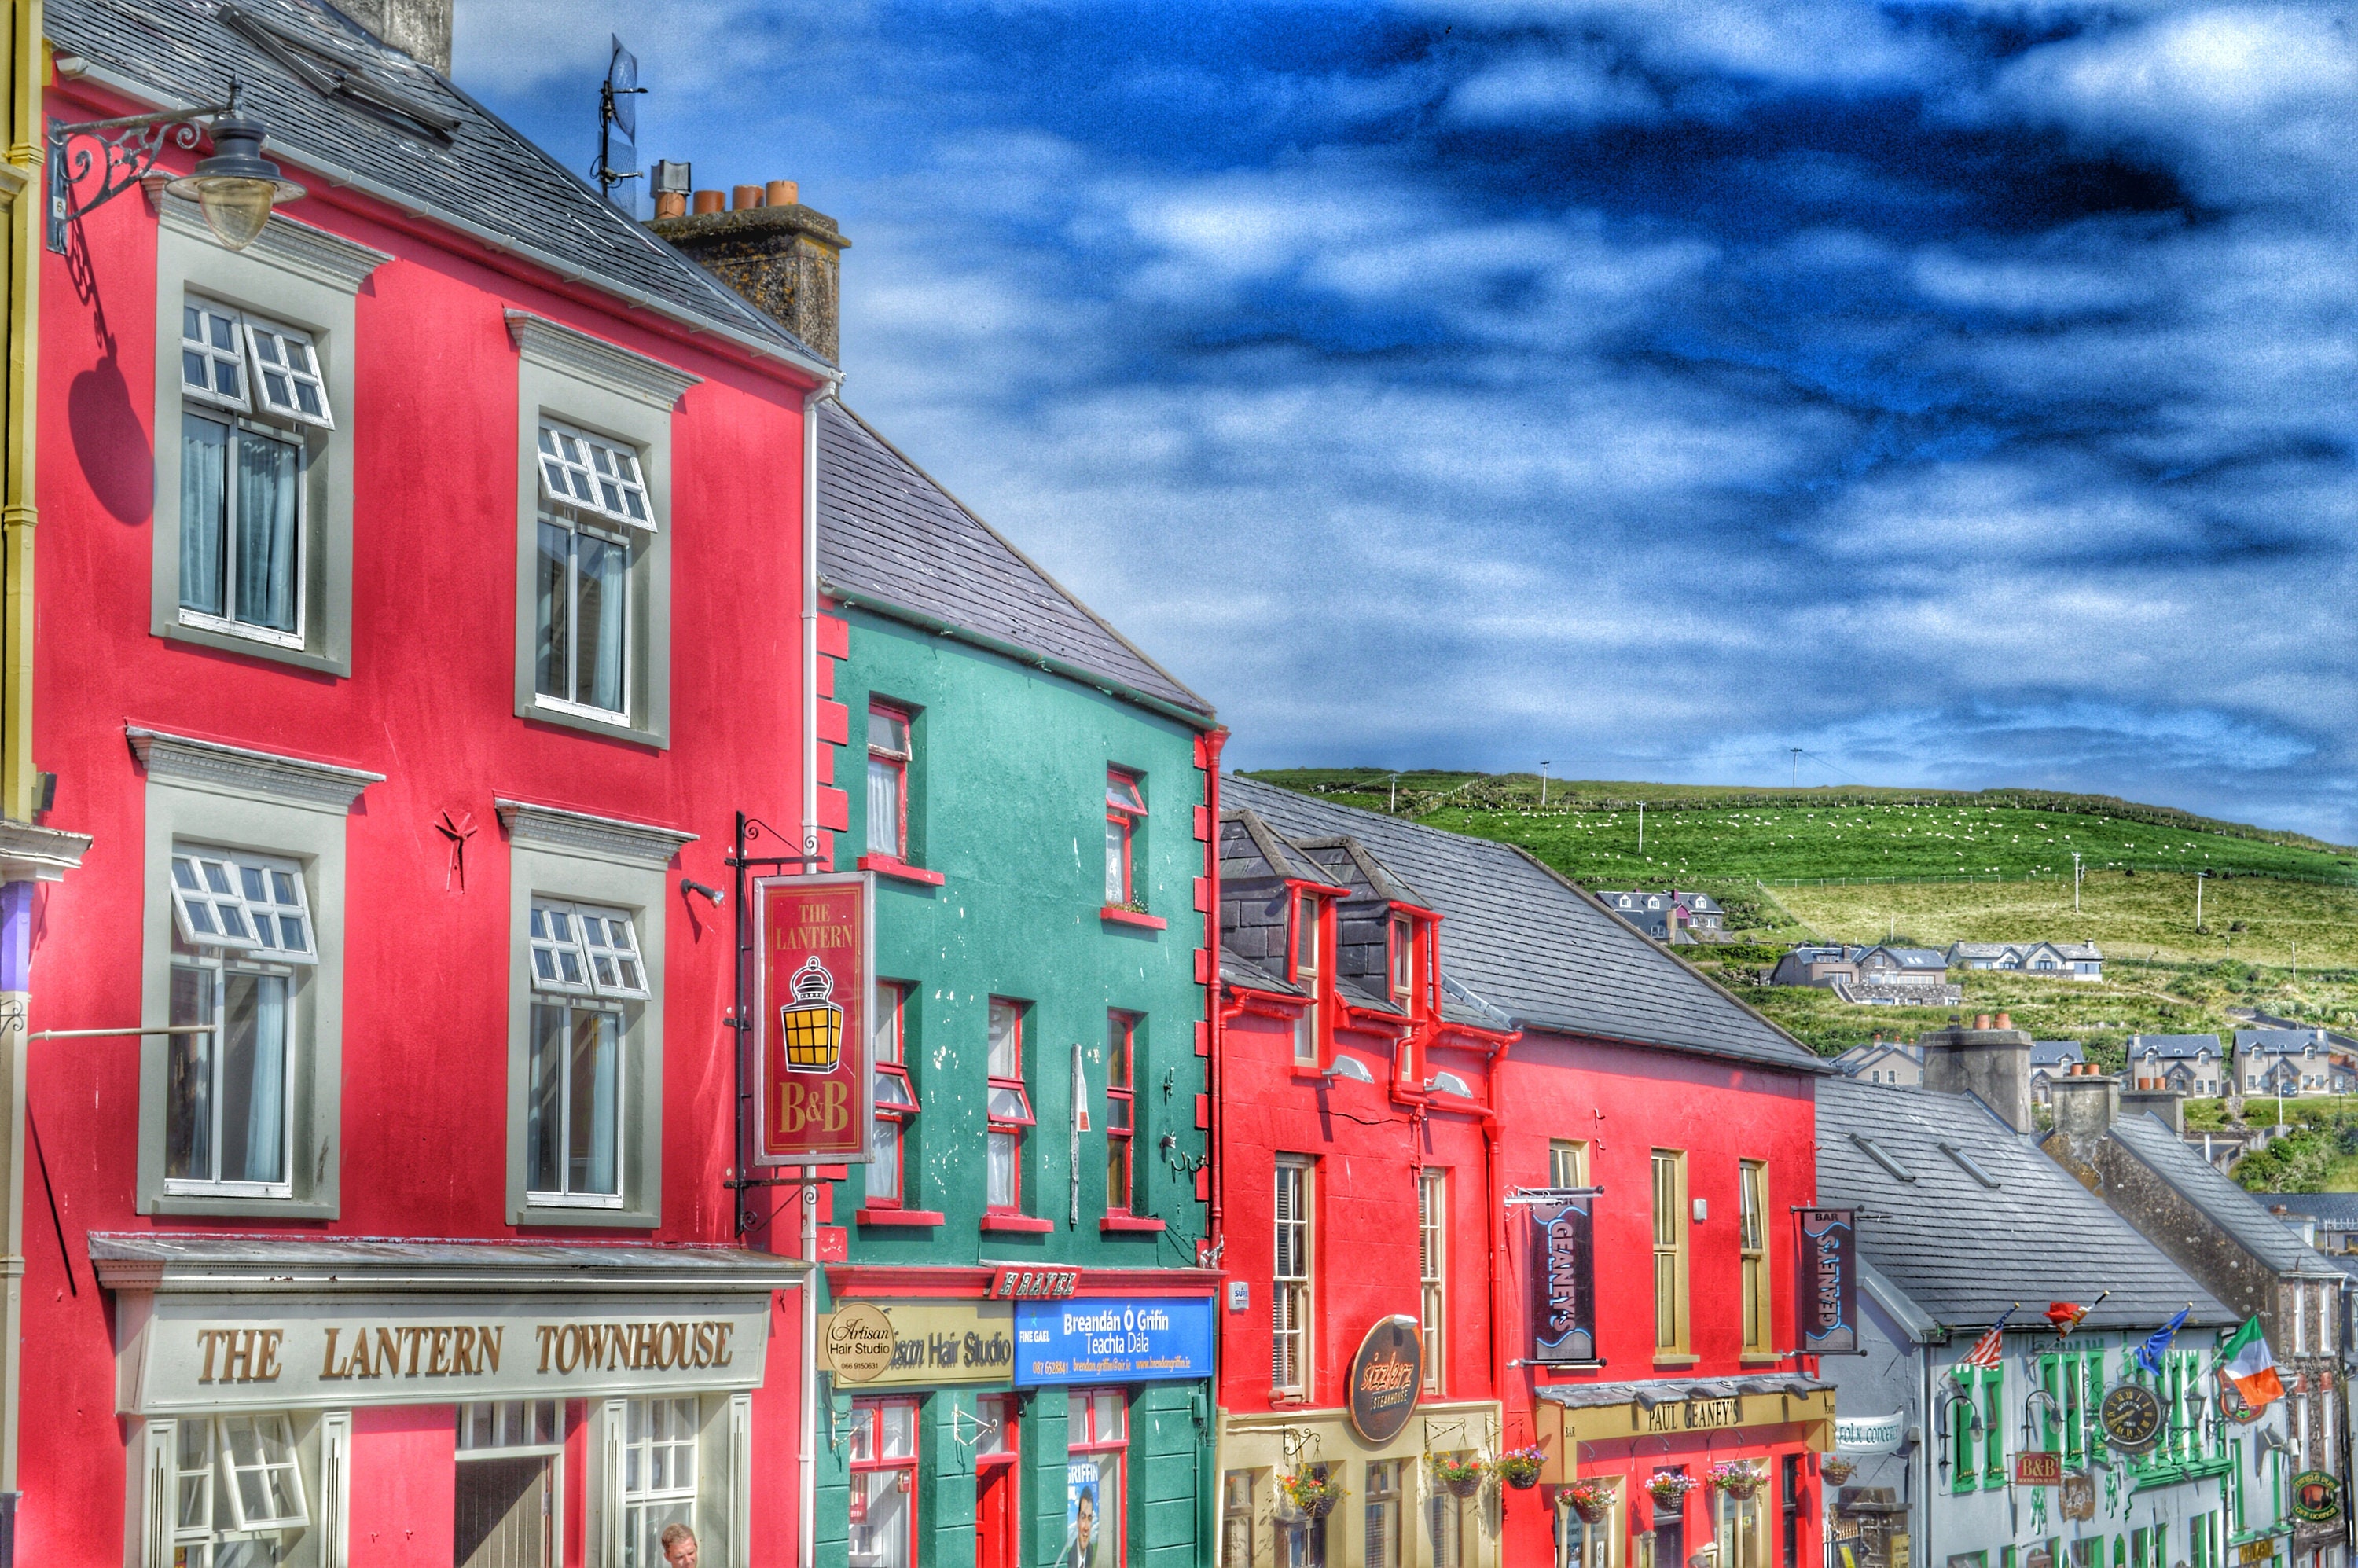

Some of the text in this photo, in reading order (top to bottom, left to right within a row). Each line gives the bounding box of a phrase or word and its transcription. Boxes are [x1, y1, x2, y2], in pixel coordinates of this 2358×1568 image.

[798, 904, 831, 924] THE
[776, 925, 853, 950] LANTERN
[779, 1081, 849, 1133] B&B
[1815, 1213, 1839, 1222] BAR
[1549, 1221, 1577, 1332] GEANEY'S
[1816, 1234, 1838, 1327] GEANEY'S
[831, 1318, 890, 1341] Artisan
[1063, 1305, 1169, 1335] Breandán Ó Grifín
[928, 1331, 961, 1364] Hair
[963, 1331, 1011, 1364] Studio
[1019, 1330, 1050, 1343] FINE GAEL
[1085, 1331, 1150, 1355] Teachta Dála
[197, 1320, 734, 1382] THE LANTERN TOWNHOUSE
[829, 1342, 890, 1355] Hair Studio
[1033, 1361, 1044, 1375] 087
[1372, 1389, 1408, 1410] STEAKHOUSE
[1649, 1400, 1739, 1431] PAUL GEANEY'S
[1838, 1423, 1863, 1444] FOLK
[2022, 1458, 2055, 1477] B&B
[2321, 1476, 2336, 1489] PUB
[2295, 1507, 2337, 1520] OFF LICENCE
